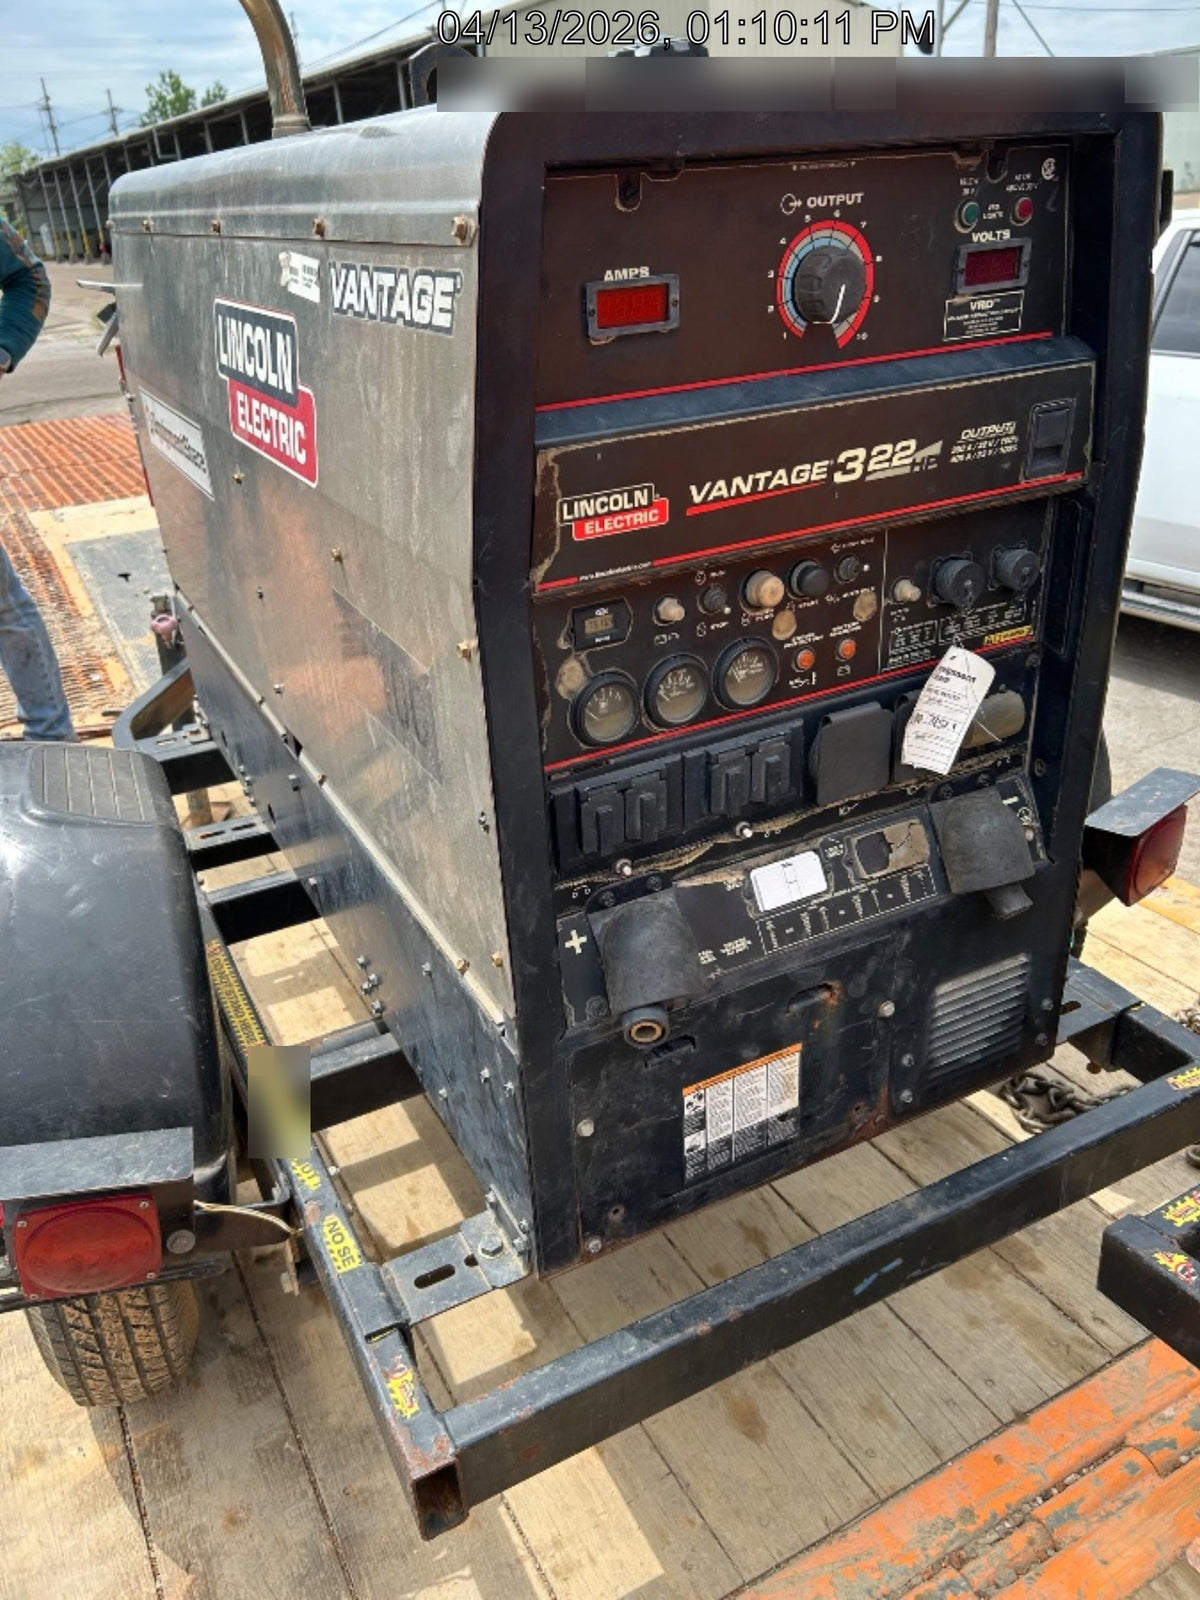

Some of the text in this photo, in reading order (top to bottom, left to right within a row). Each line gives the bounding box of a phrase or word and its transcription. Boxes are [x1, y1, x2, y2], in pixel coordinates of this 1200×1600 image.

[806, 192, 864, 208] OUTPUT
[972, 229, 1011, 243] VOLTS
[604, 266, 650, 282] AMPS
[330, 266, 455, 328] VANTAGE
[218, 315, 294, 394] LINCOLN
[236, 390, 307, 465] ELECTRIC
[690, 460, 830, 503] VANTAGE
[833, 439, 918, 484] 322
[562, 488, 649, 520] LINCOLN
[584, 509, 660, 535] ELECTRIC
[325, 1220, 357, 1268] NO SE
